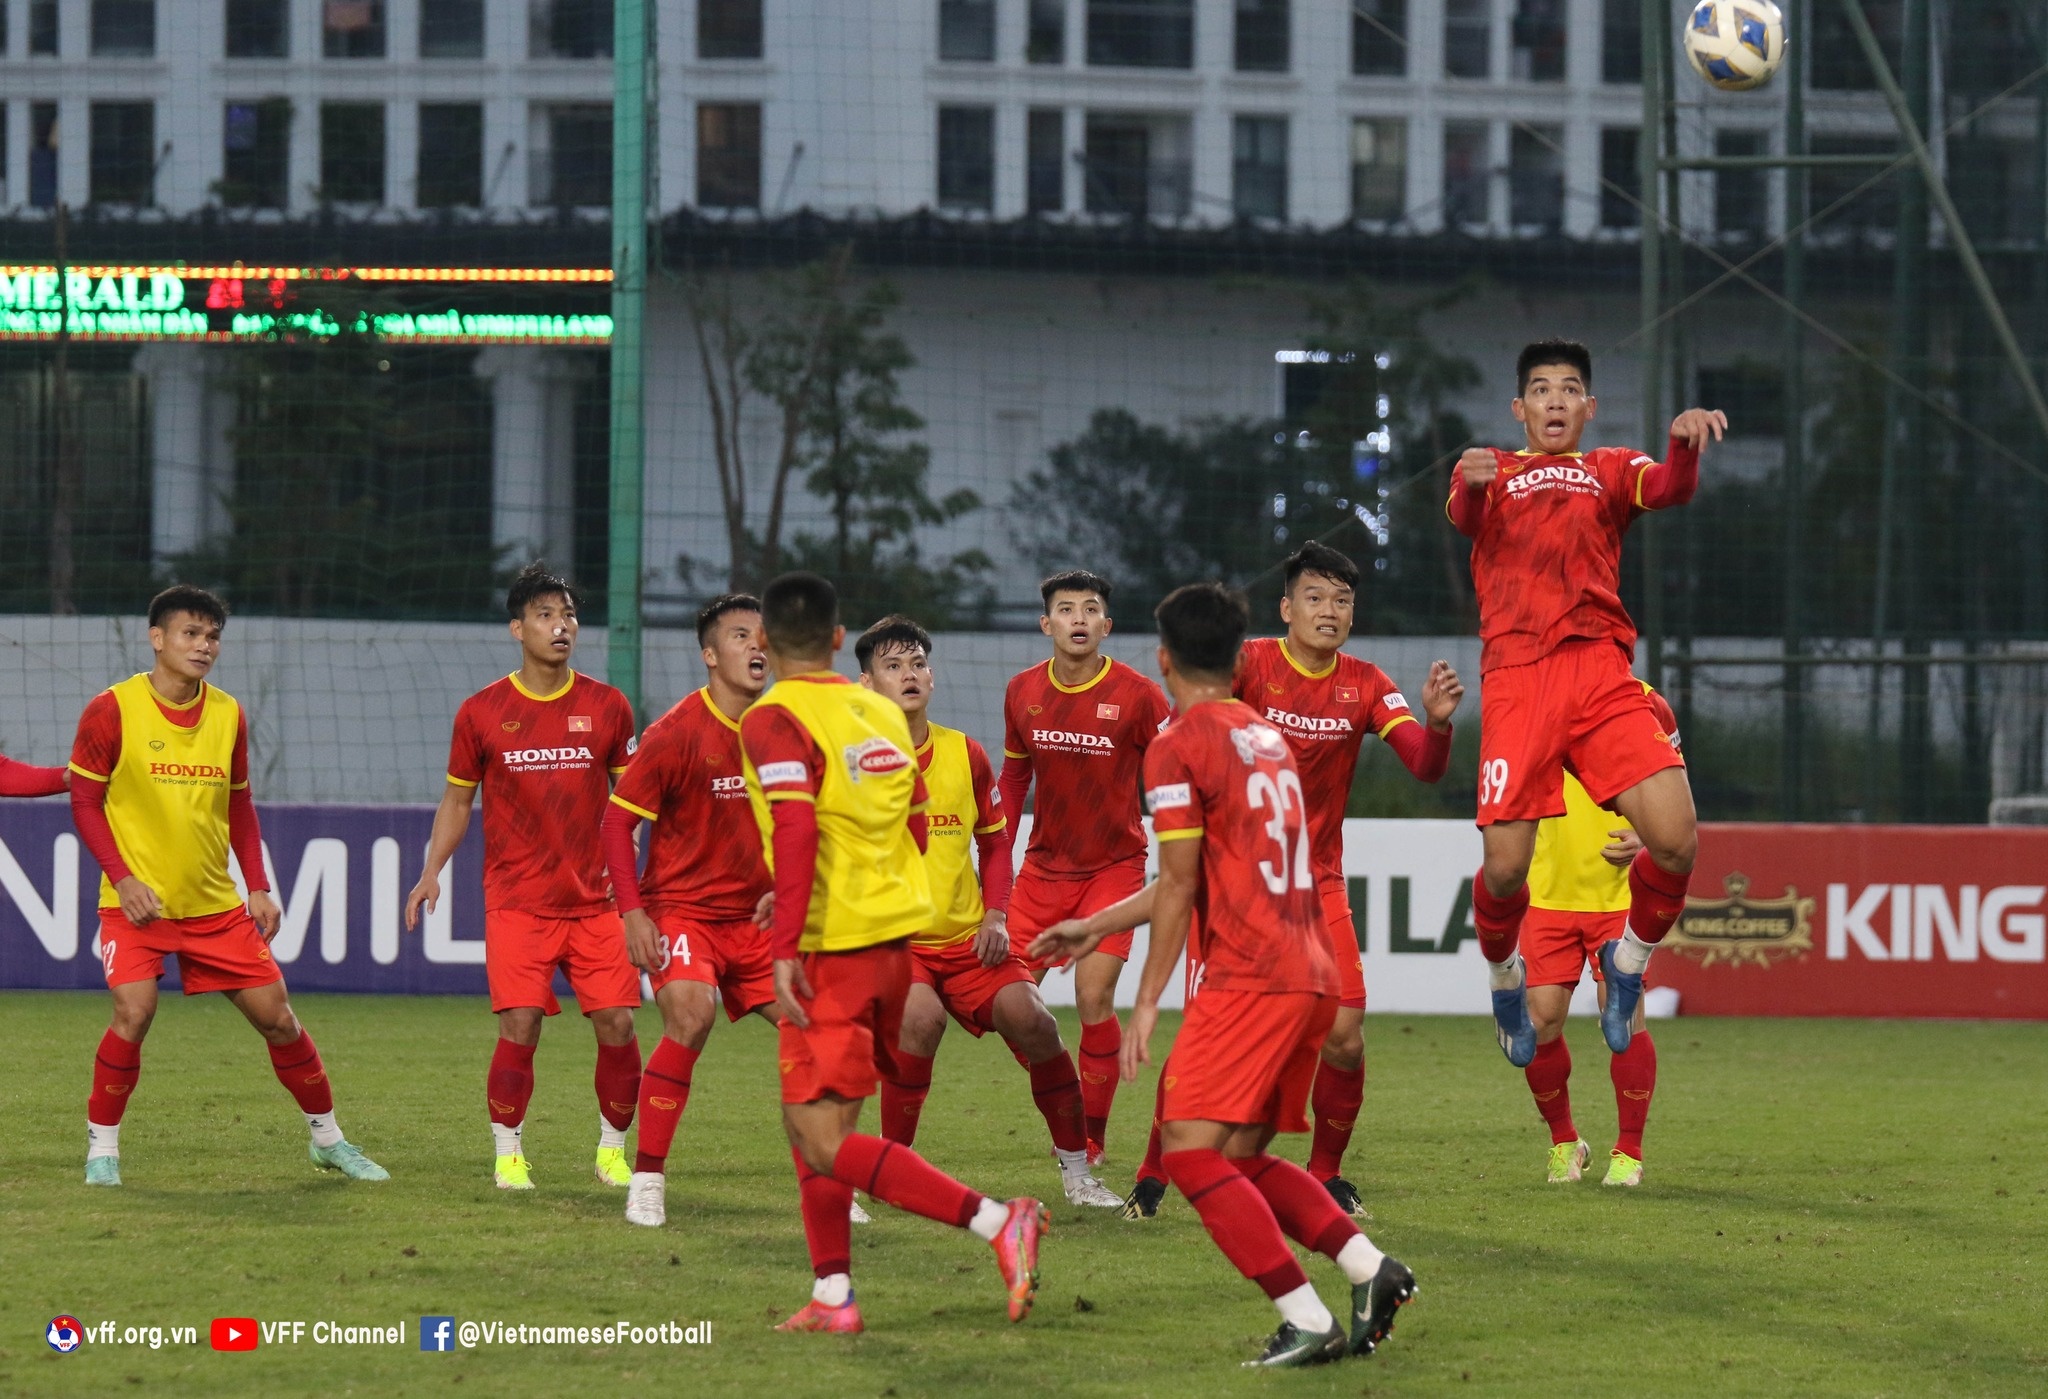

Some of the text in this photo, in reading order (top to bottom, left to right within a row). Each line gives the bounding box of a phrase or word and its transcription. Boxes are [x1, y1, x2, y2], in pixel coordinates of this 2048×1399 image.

[1507, 466, 1603, 493] HONDA
[1511, 491, 1529, 500] The
[1566, 484, 1599, 497] Dreams
[1265, 707, 1354, 732] HONDA
[1032, 729, 1115, 749] HONDA
[1282, 728, 1308, 739] Power
[1308, 732, 1318, 740] of
[502, 746, 594, 764] HONDA
[1035, 742, 1049, 750] The
[1049, 743, 1072, 752] Power
[1082, 747, 1112, 757] Dreams
[149, 763, 227, 779] HONDA
[508, 761, 590, 773] The Power of Dreams
[199, 780, 224, 788] Dreams
[1481, 757, 1509, 806] 39
[715, 792, 731, 800] The
[934, 829, 962, 837] Dreams
[1246, 768, 1313, 895] 32
[1826, 882, 2047, 962] KING
